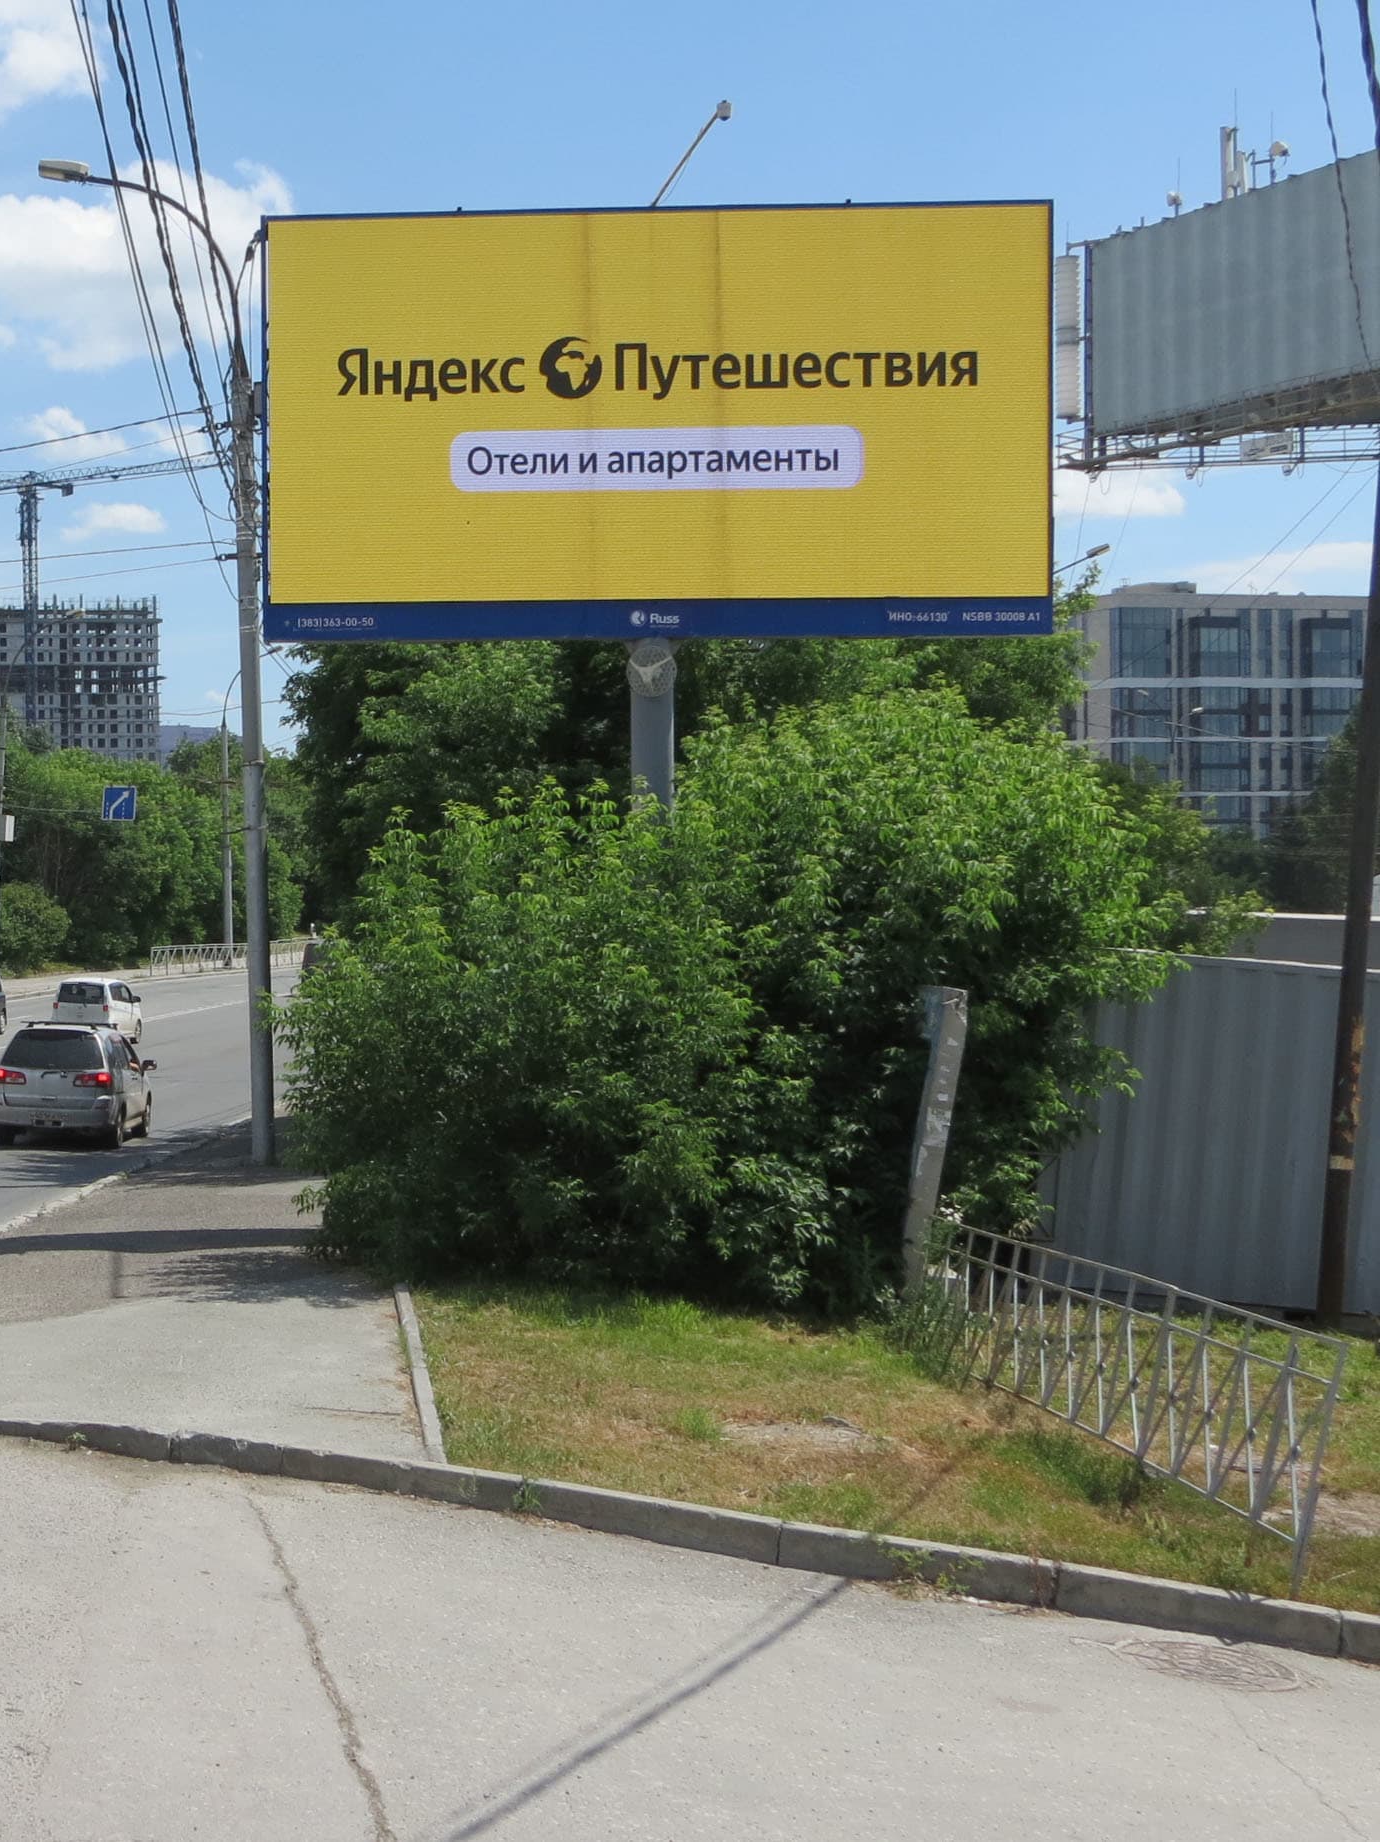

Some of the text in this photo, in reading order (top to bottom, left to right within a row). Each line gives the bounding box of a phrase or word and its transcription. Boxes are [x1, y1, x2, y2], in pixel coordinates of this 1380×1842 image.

[337, 342, 979, 402] Яндекс Путешествия
[466, 446, 840, 480] Отели и апартаменты
[649, 613, 680, 624] Russ
